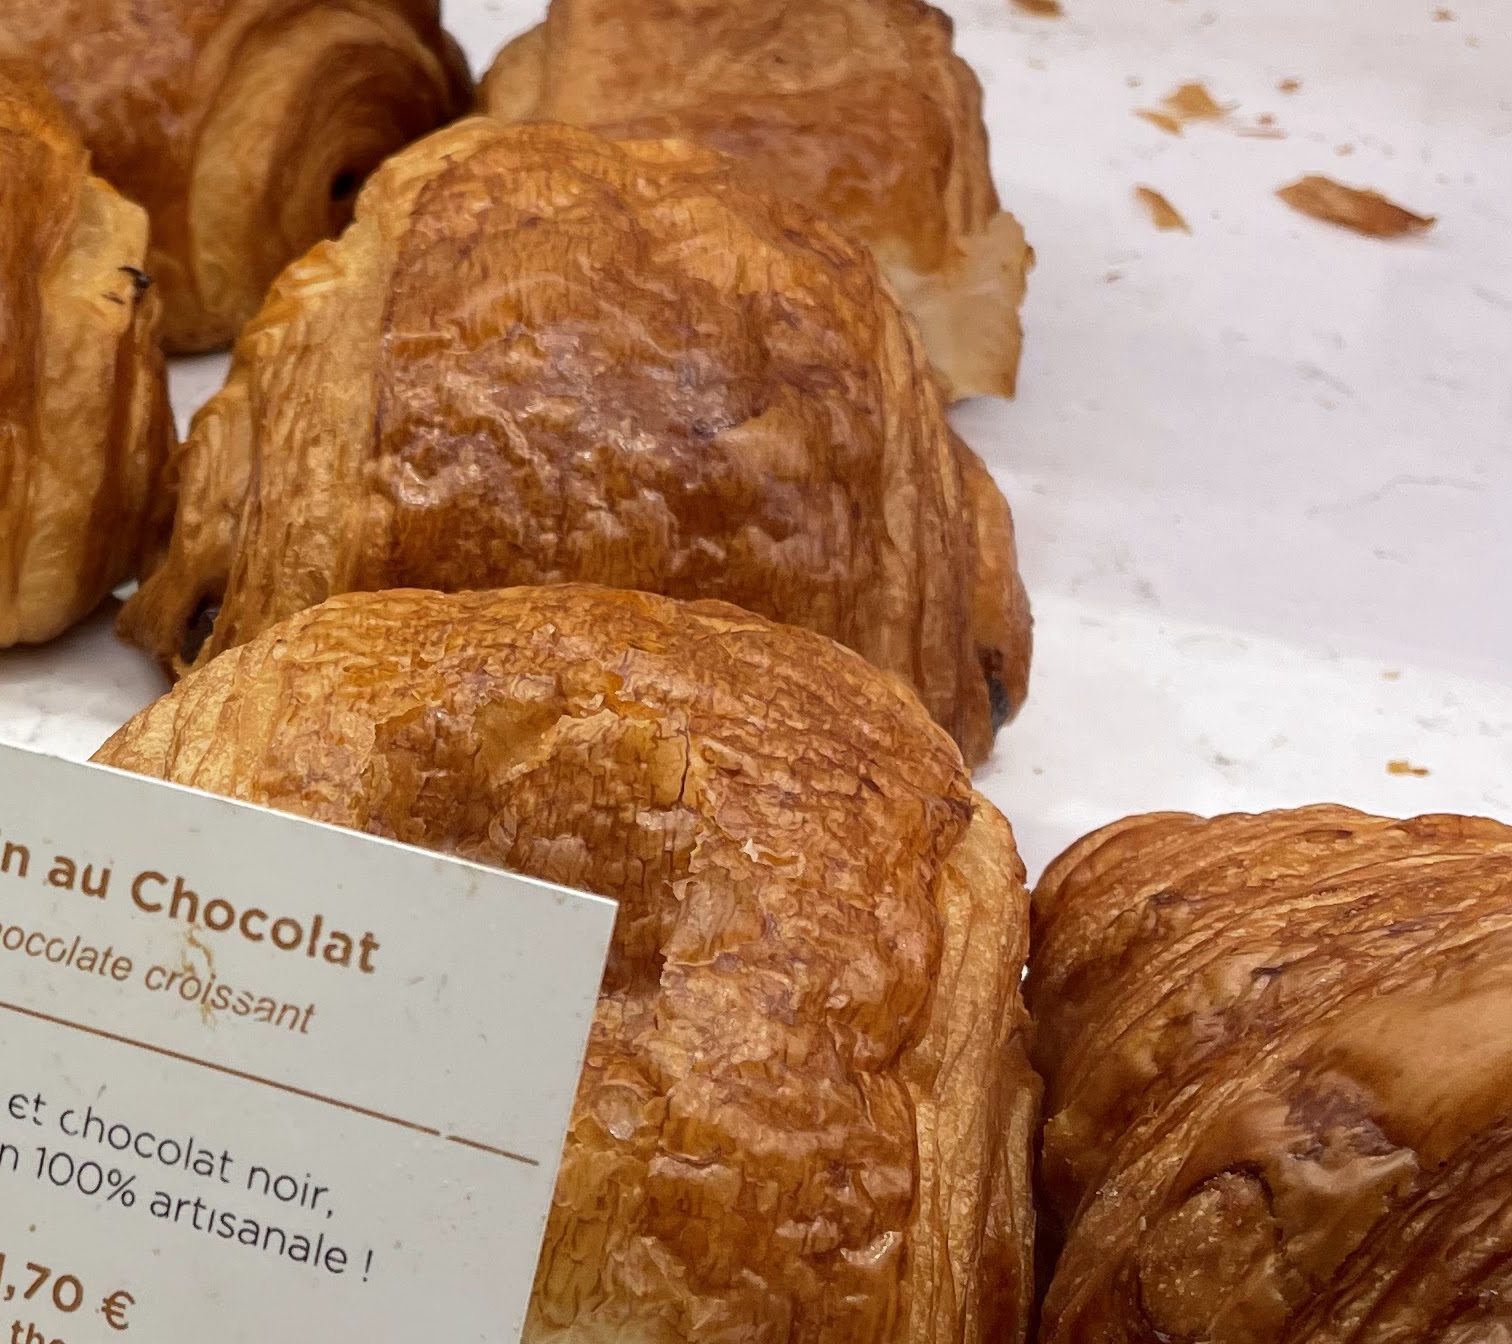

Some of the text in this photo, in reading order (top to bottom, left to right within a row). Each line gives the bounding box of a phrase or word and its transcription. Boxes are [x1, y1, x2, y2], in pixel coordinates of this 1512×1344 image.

[47, 855, 112, 900] au
[130, 869, 380, 974] Chocolat
[145, 965, 317, 1034] croissant
[8, 1093, 46, 1126] et
[60, 1105, 233, 1184] chocolat
[247, 1160, 337, 1219] noir,
[35, 1147, 136, 1208] 100%
[150, 1188, 349, 1274] artisanale
[100, 1290, 136, 1331] €
